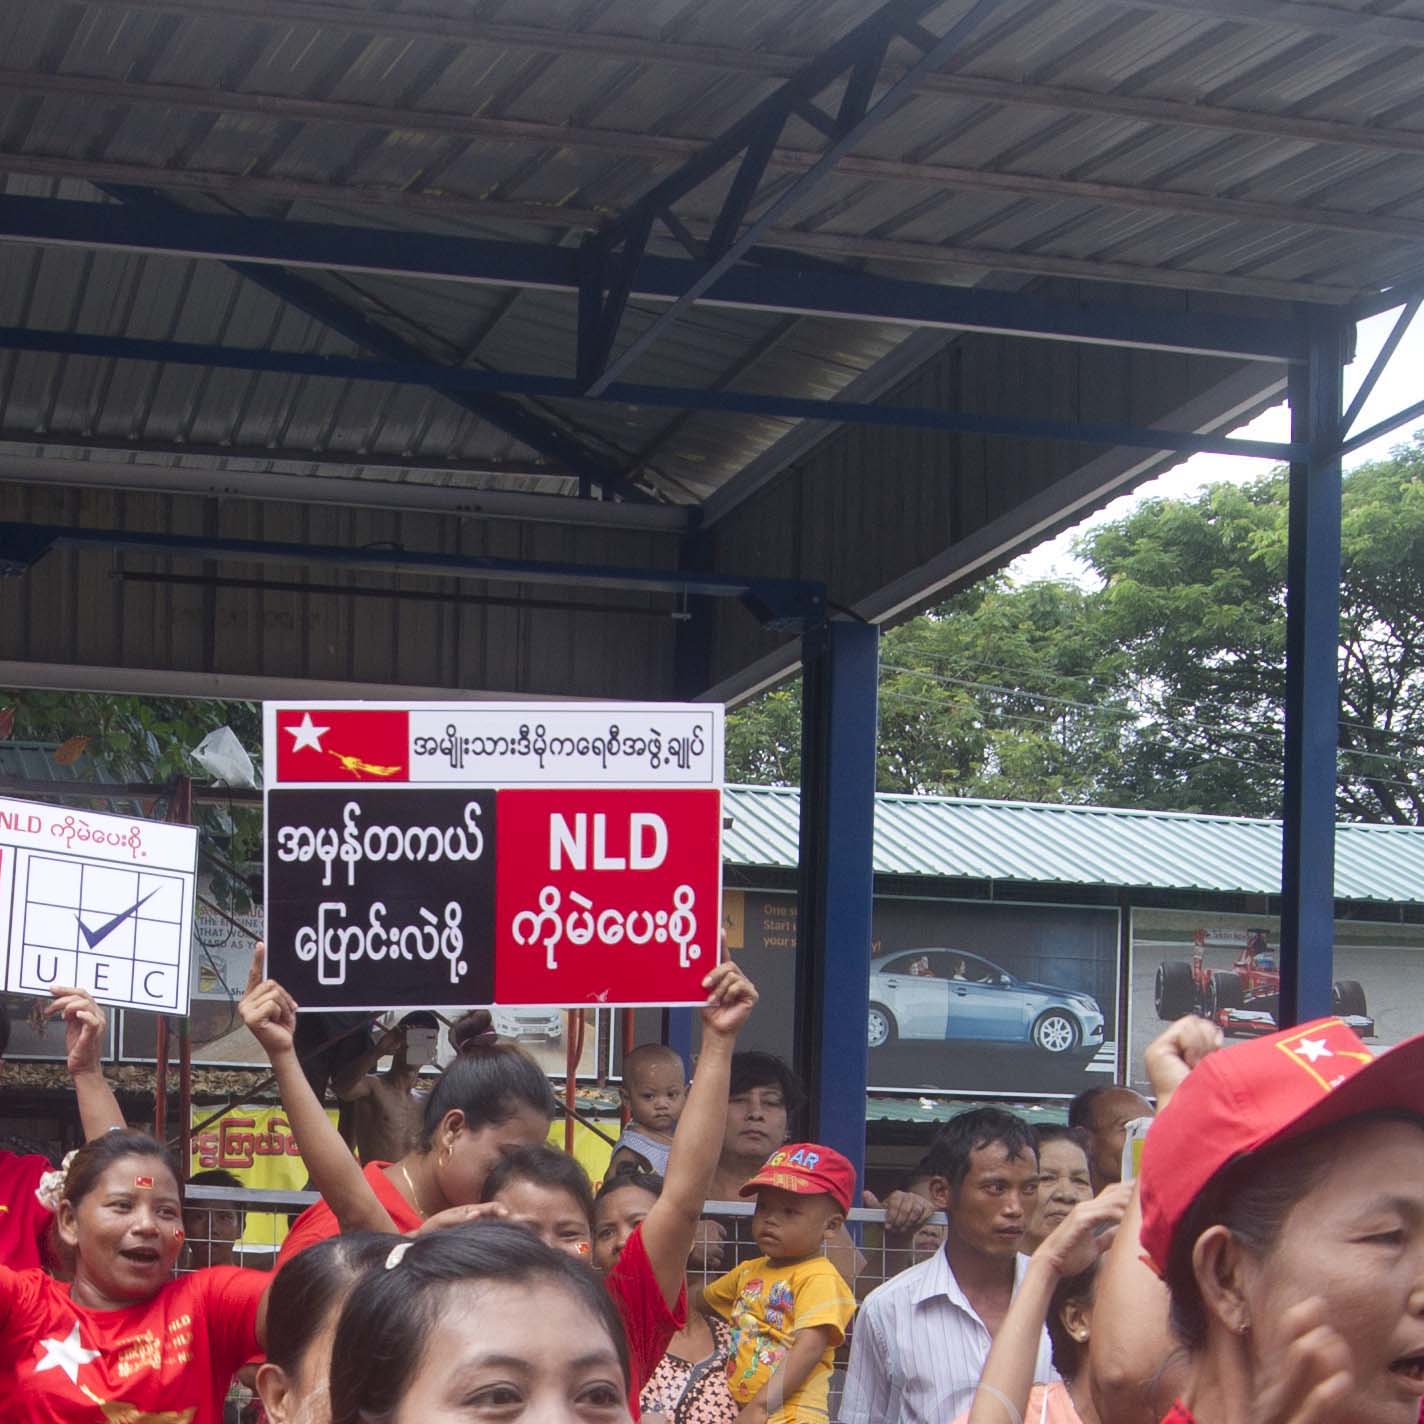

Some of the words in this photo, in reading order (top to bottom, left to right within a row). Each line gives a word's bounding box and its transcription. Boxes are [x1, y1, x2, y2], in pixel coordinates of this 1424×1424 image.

[276, 801, 484, 886] အမှန်တကယ်
[549, 812, 669, 871] NLD
[294, 900, 468, 985] ပြောင်းလဲဖို့
